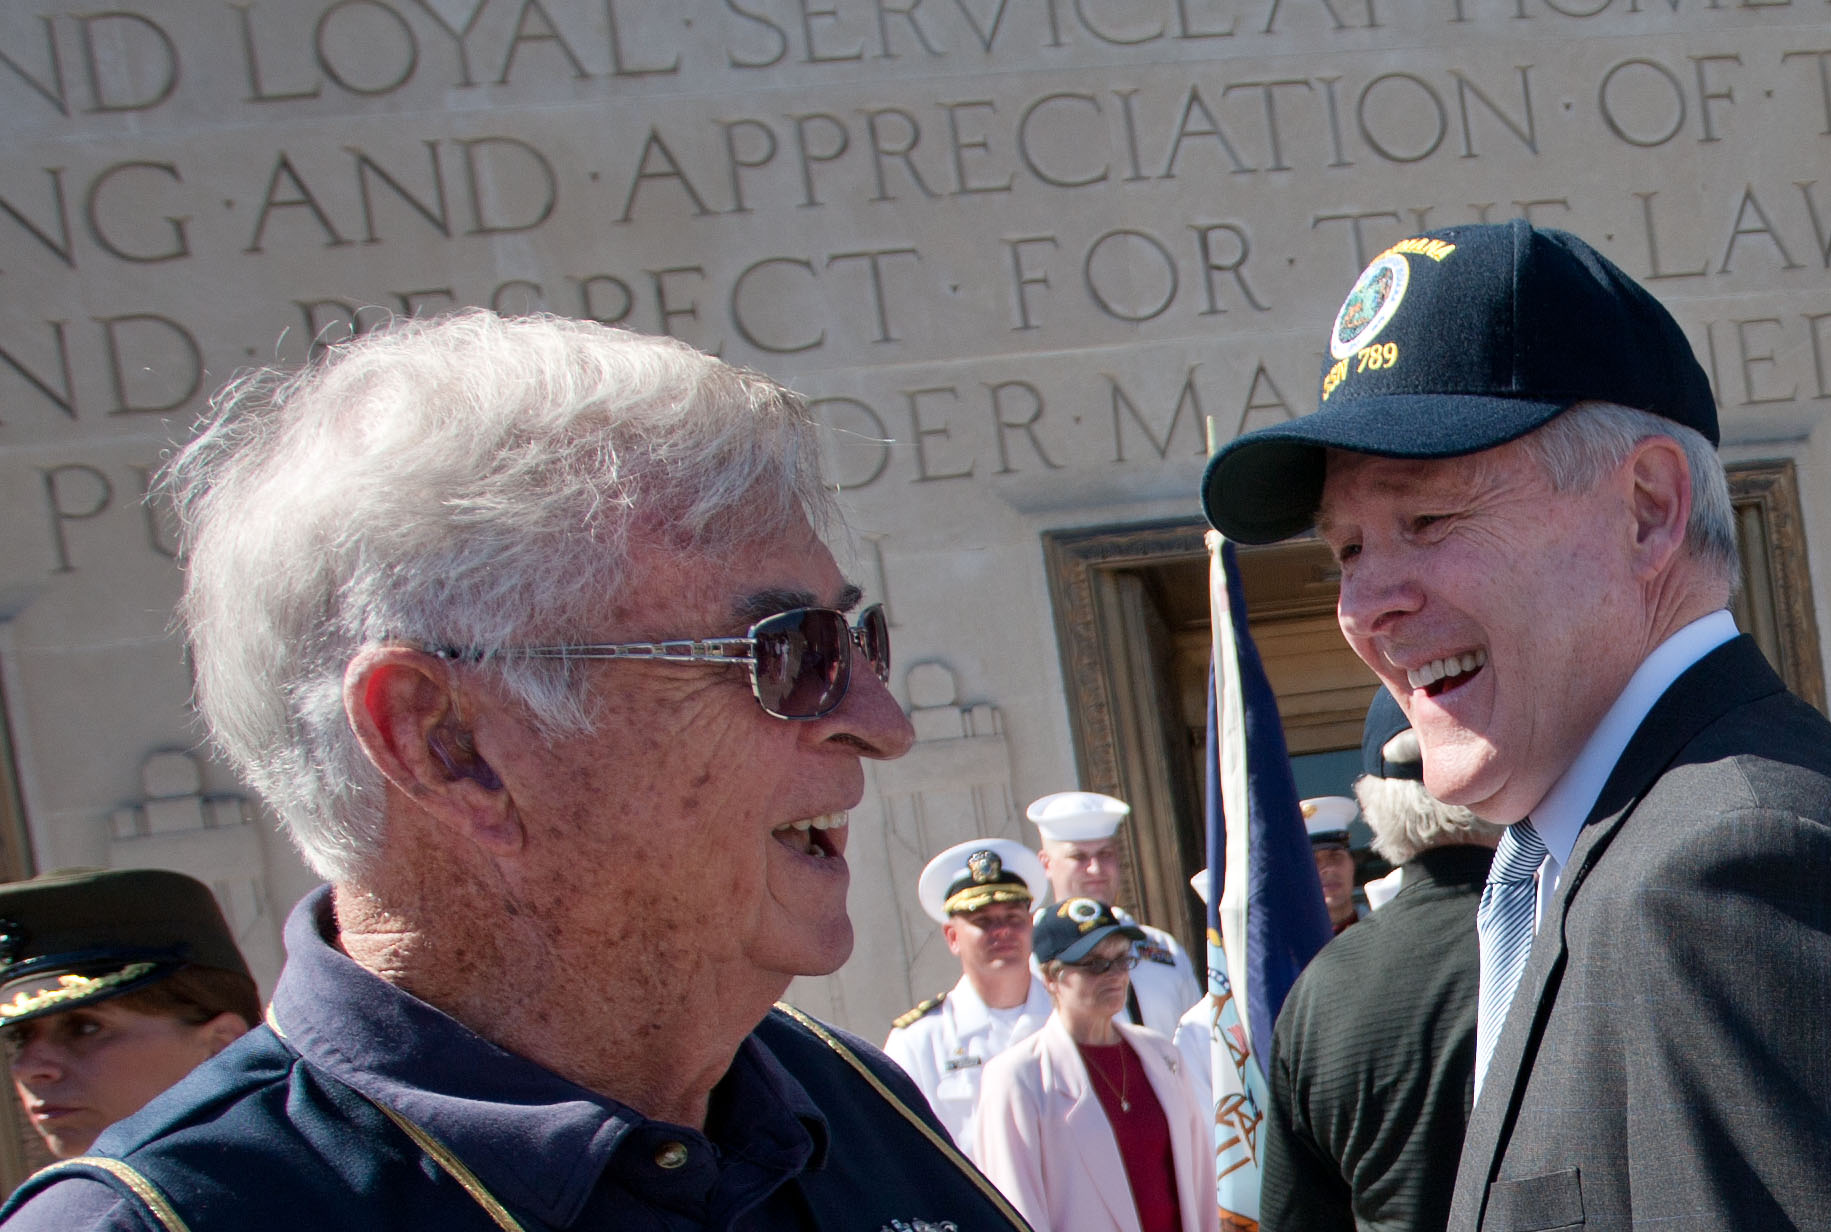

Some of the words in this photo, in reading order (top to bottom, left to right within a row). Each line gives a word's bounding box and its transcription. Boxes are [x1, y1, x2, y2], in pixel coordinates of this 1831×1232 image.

[241, 0, 681, 103] LOYAL
[244, 135, 558, 254] AND
[614, 65, 1541, 224] APPRECIATION
[1600, 54, 1742, 148] OF
[290, 248, 921, 354] RPECT
[1000, 222, 1270, 331] FOR
[1357, 342, 1398, 373] 789
